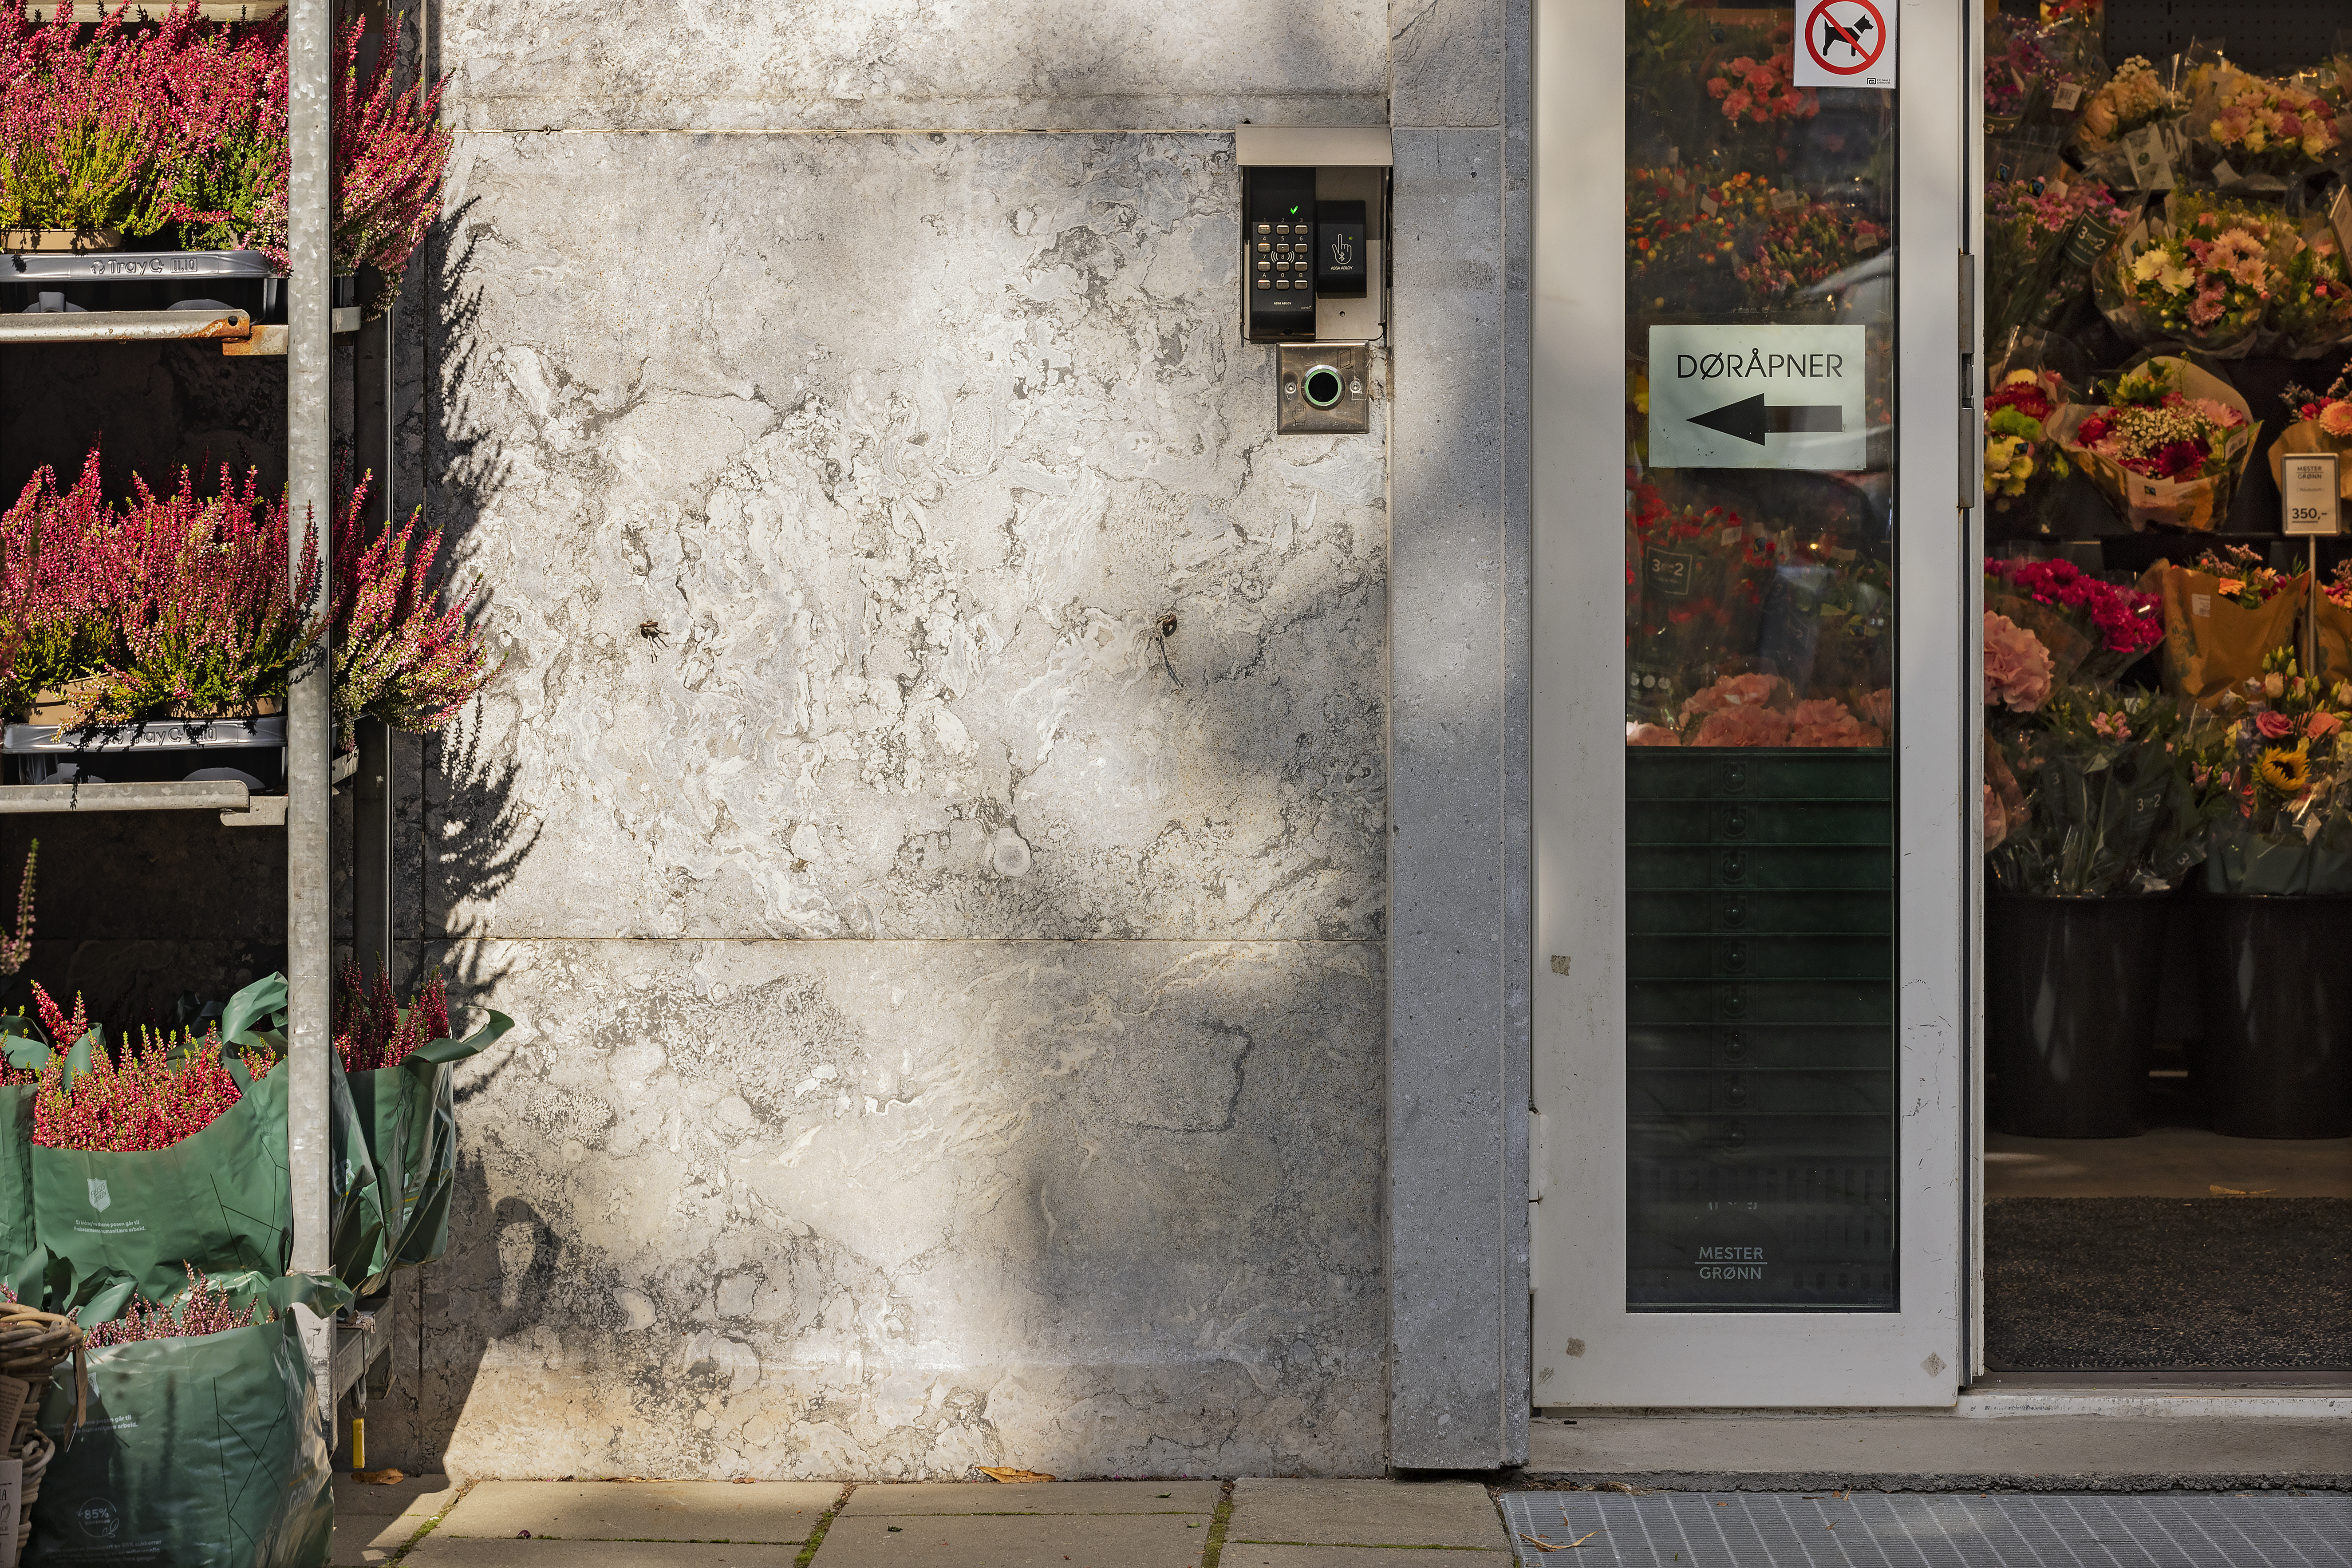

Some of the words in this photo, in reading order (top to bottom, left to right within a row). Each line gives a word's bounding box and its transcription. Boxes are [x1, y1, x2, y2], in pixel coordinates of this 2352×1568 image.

[2078, 226, 2088, 239] 3
[2094, 238, 2106, 251] 2
[1677, 348, 1843, 380] DØRÅPNER
[2292, 508, 2327, 520] 350,-
[1652, 559, 1660, 572] 3
[1674, 563, 1684, 577] 2
[2137, 798, 2144, 812] 3
[2154, 794, 2161, 808] 2
[1699, 1247, 1764, 1260] MESTER
[1699, 1266, 1762, 1280] GRØNN
[96, 1417, 114, 1426] posen
[114, 1415, 125, 1424] går
[84, 1508, 109, 1519] 85%
